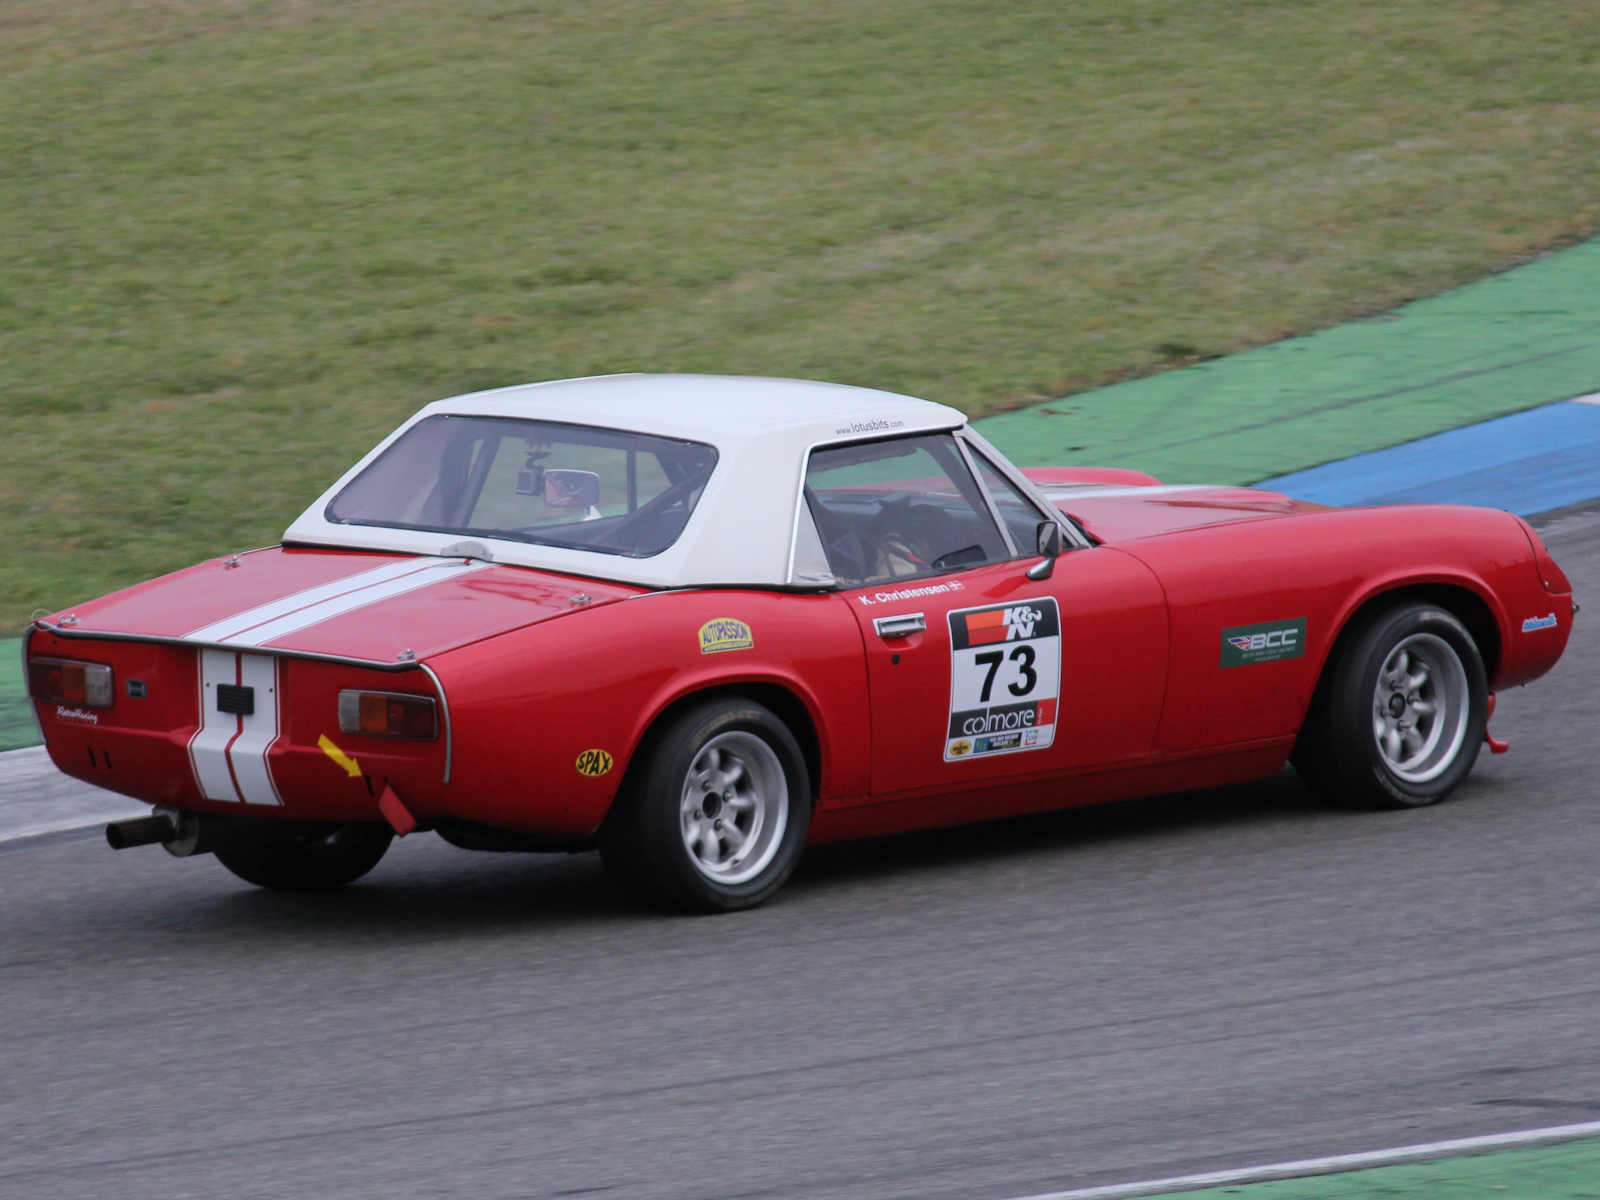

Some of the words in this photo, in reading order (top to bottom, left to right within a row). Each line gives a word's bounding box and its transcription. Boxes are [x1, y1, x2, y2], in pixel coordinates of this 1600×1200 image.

[835, 419, 905, 435] www.lotusbits.com
[858, 595, 877, 605] K.
[875, 583, 950, 603] Christensen
[703, 620, 749, 645] AUTOPASSION
[1250, 628, 1299, 650] BCC
[975, 644, 1038, 703] 73
[963, 707, 1035, 735] colmore
[577, 751, 611, 774] SPAX
